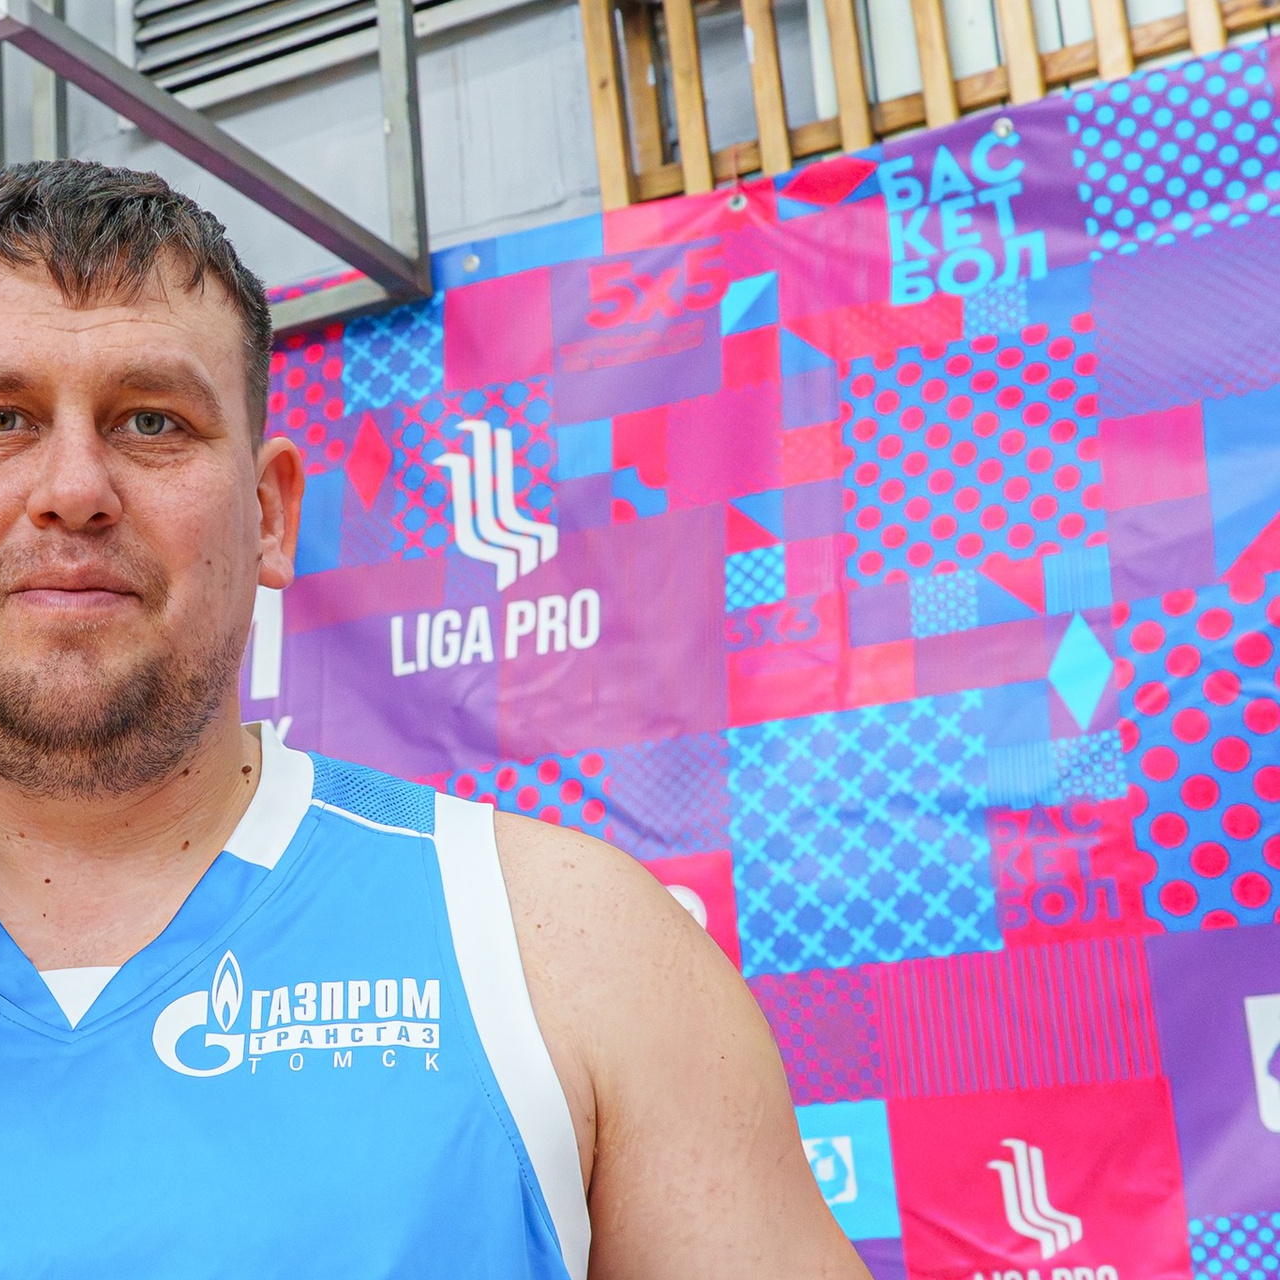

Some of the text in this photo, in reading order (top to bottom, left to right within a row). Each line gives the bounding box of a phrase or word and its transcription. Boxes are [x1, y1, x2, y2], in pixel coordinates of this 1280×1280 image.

[877, 129, 1025, 213] БАС
[889, 180, 1023, 261] КЕТ
[891, 229, 1048, 306] БОЛ
[390, 588, 601, 677] LIGA PRO
[250, 977, 440, 1030] ГАЗПРОМ
[254, 1024, 436, 1052] ТРАНСГАЗ
[247, 1048, 440, 1075] ТОМСК
